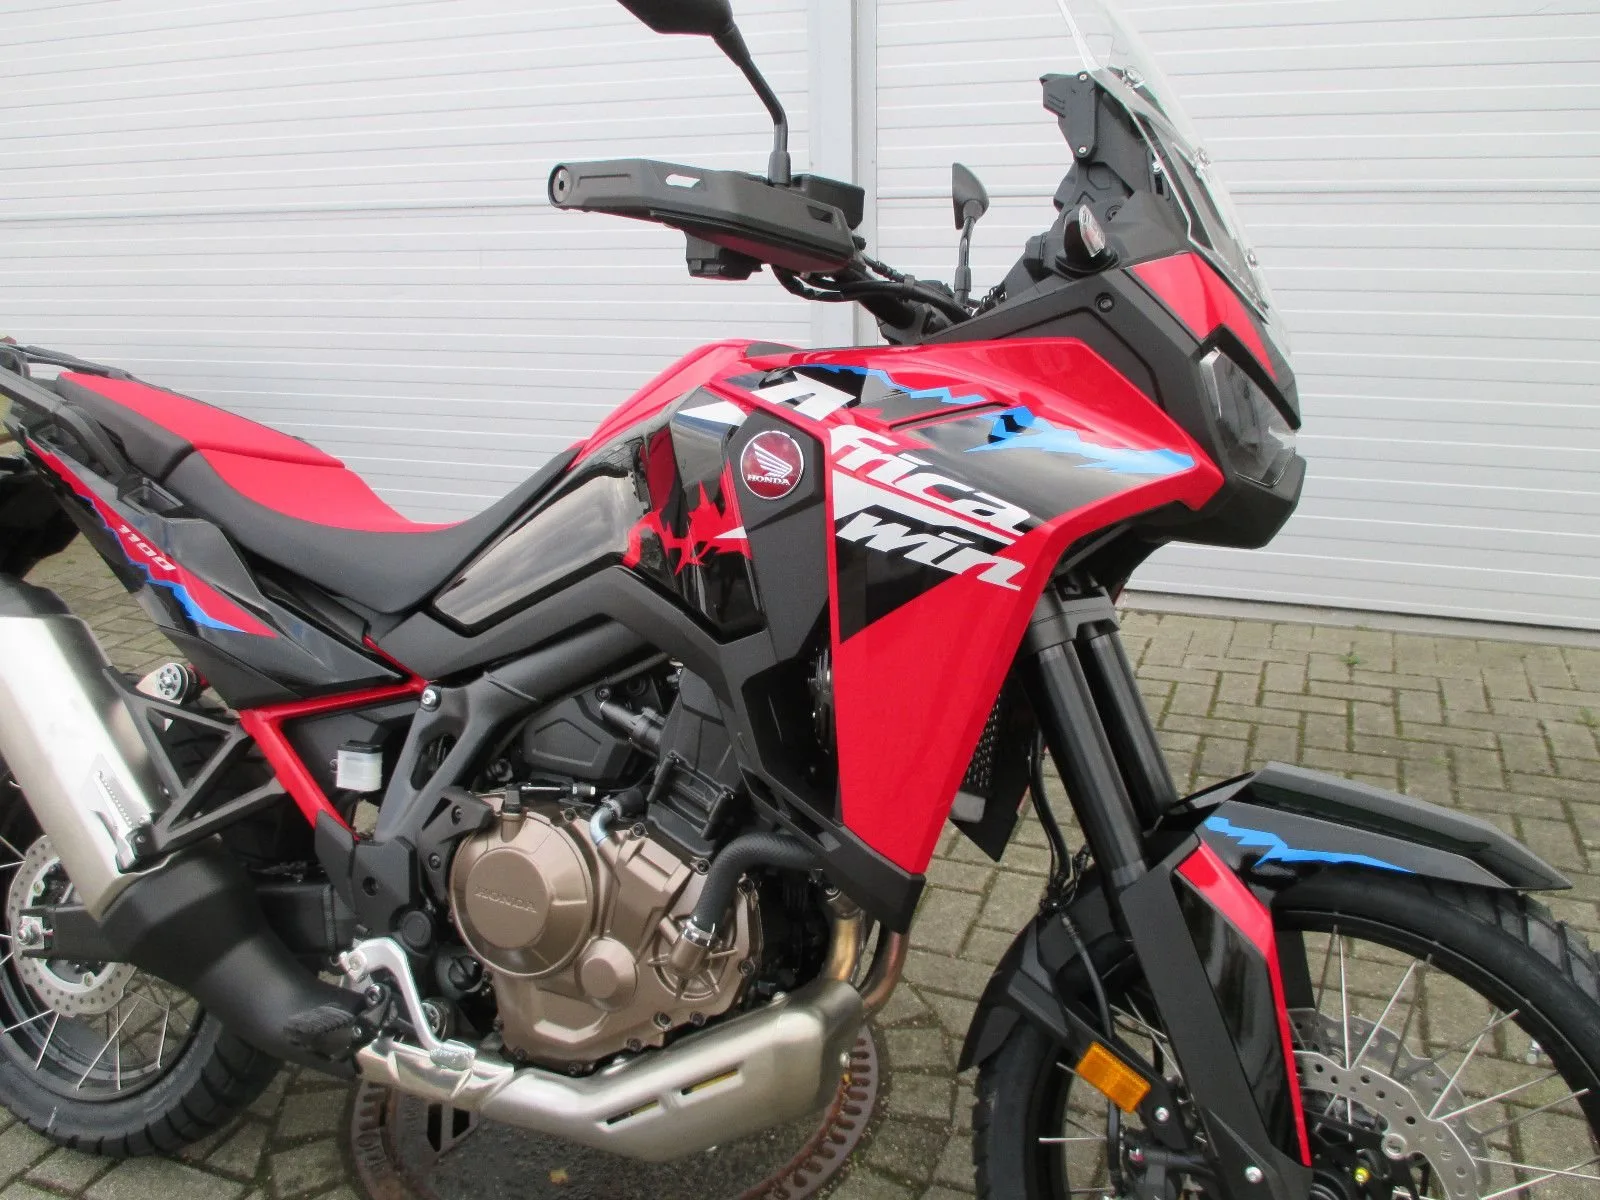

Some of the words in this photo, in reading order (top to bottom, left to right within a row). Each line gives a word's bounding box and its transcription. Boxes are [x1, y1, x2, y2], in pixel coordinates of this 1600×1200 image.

[747, 473, 791, 486] HONDA
[119, 524, 177, 571] 1100
[473, 887, 538, 914] HONDA
